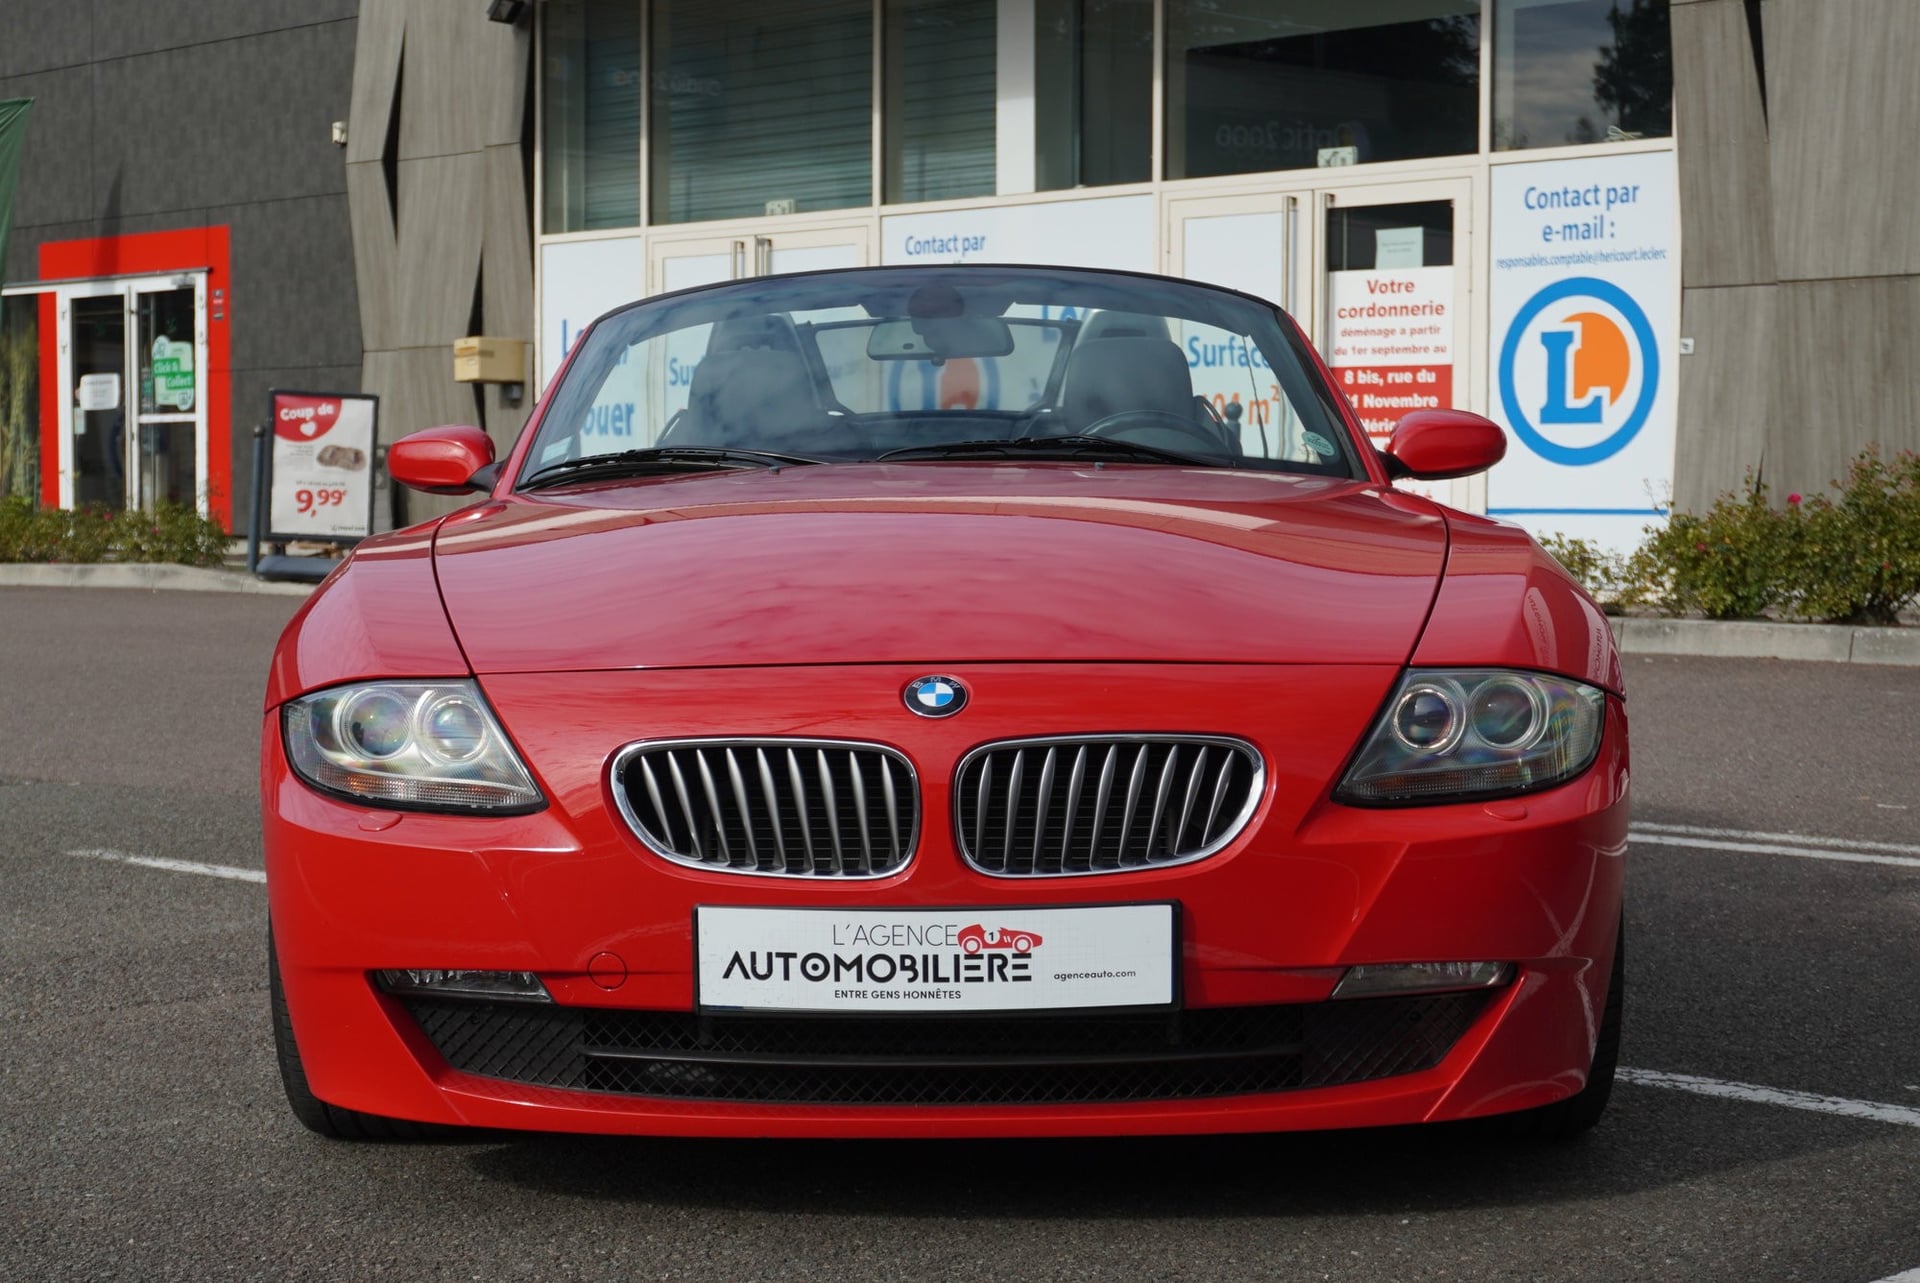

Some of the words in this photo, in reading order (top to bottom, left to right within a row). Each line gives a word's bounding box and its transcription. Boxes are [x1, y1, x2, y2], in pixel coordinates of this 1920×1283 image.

[1524, 184, 1601, 210] Contact
[1606, 185, 1640, 211] par
[1542, 214, 1604, 242] e-mail
[905, 234, 958, 255] Contact
[962, 235, 985, 258] par
[1367, 279, 1415, 294] Votre
[1337, 301, 1445, 319] cordonnerie
[1410, 324, 1441, 337] partir
[1188, 335, 1270, 368] Surfac
[1371, 344, 1430, 356] septembre
[1344, 370, 1354, 384] 8
[1357, 370, 1384, 386] bis,
[1387, 371, 1414, 383] rue
[1416, 369, 1437, 383] du
[1346, 394, 1359, 409] 1
[1363, 393, 1439, 408] Novembre
[280, 406, 315, 422] Coup
[317, 402, 335, 416] de
[582, 402, 635, 436] ouer
[833, 924, 958, 946] L'AGENCE
[1053, 970, 1137, 982] agenceauto.com
[834, 990, 868, 999] ENTRE
[871, 990, 901, 999] GENS
[903, 988, 962, 999] HONNÊTES
